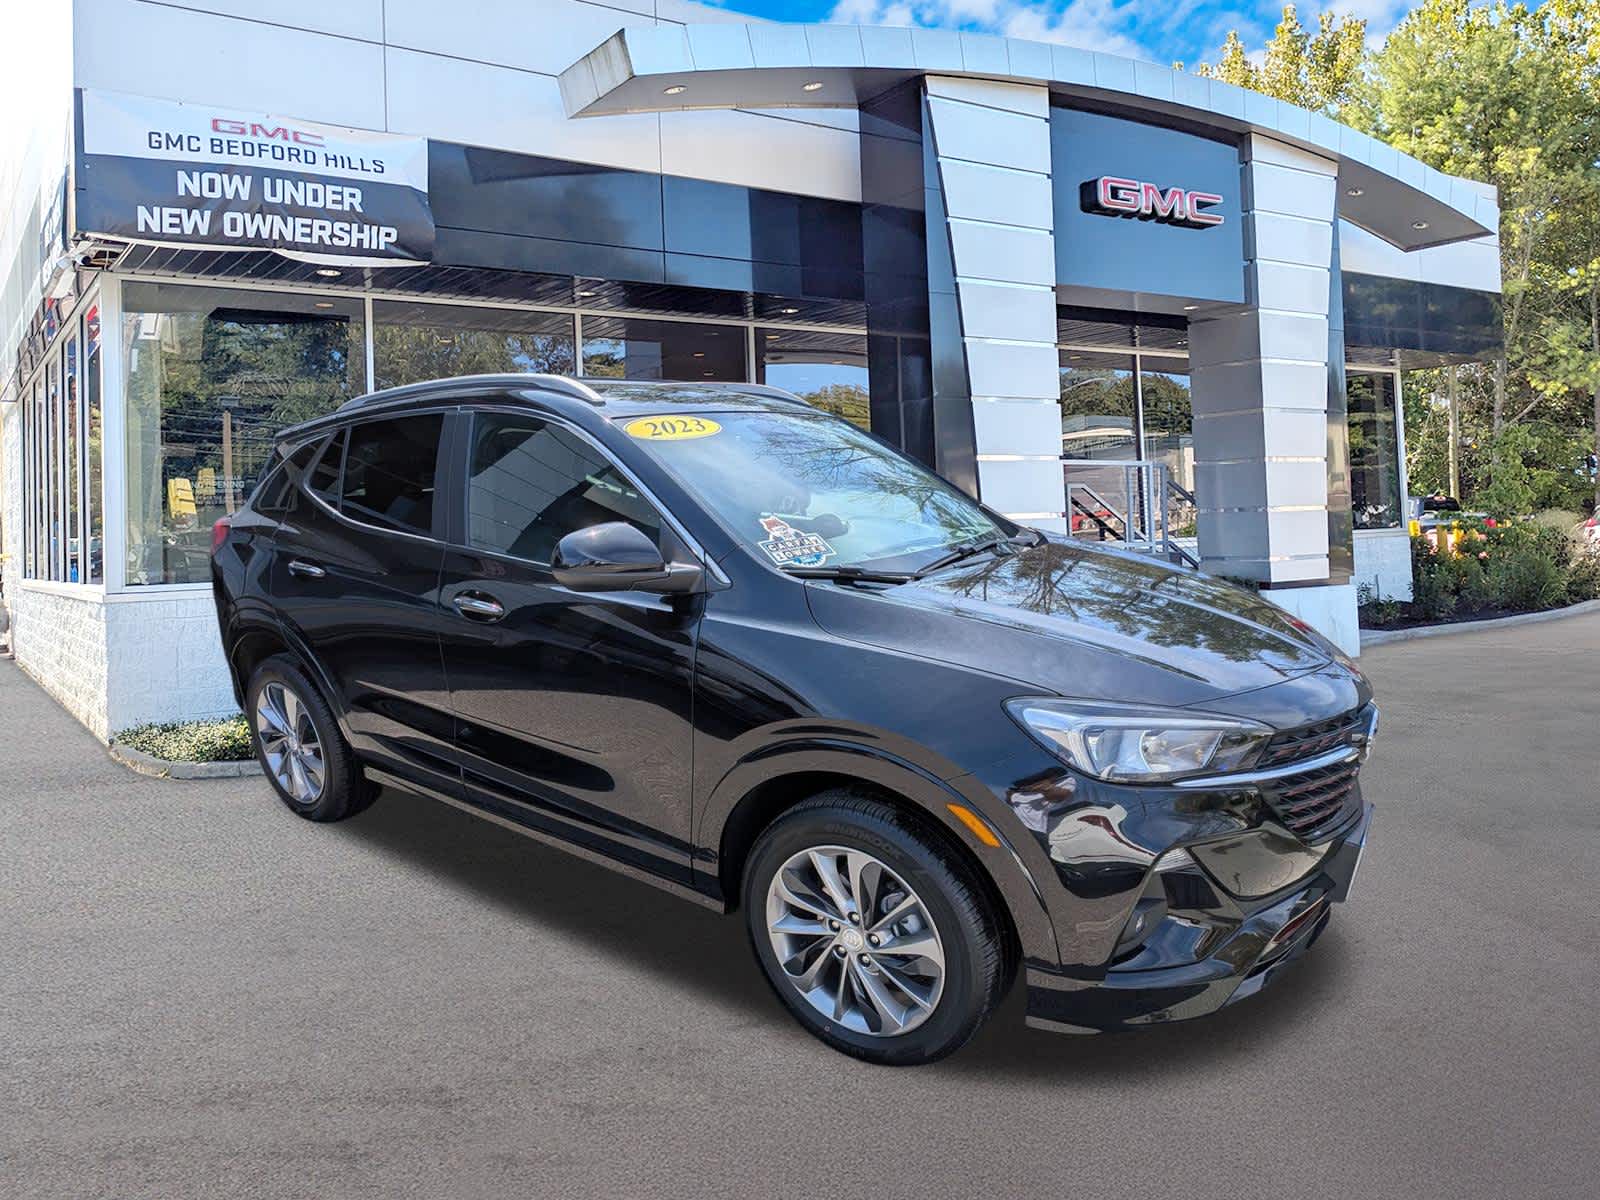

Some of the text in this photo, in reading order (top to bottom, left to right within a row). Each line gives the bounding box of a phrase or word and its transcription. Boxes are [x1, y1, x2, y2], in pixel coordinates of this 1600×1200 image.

[148, 131, 385, 174] GMC BEDFORD HILLS
[211, 118, 325, 147] GMC
[177, 170, 363, 213] NOW UNDER
[1097, 175, 1225, 225] GMC
[136, 205, 398, 250] NEW OWNERSHIP
[644, 419, 706, 436] 2023
